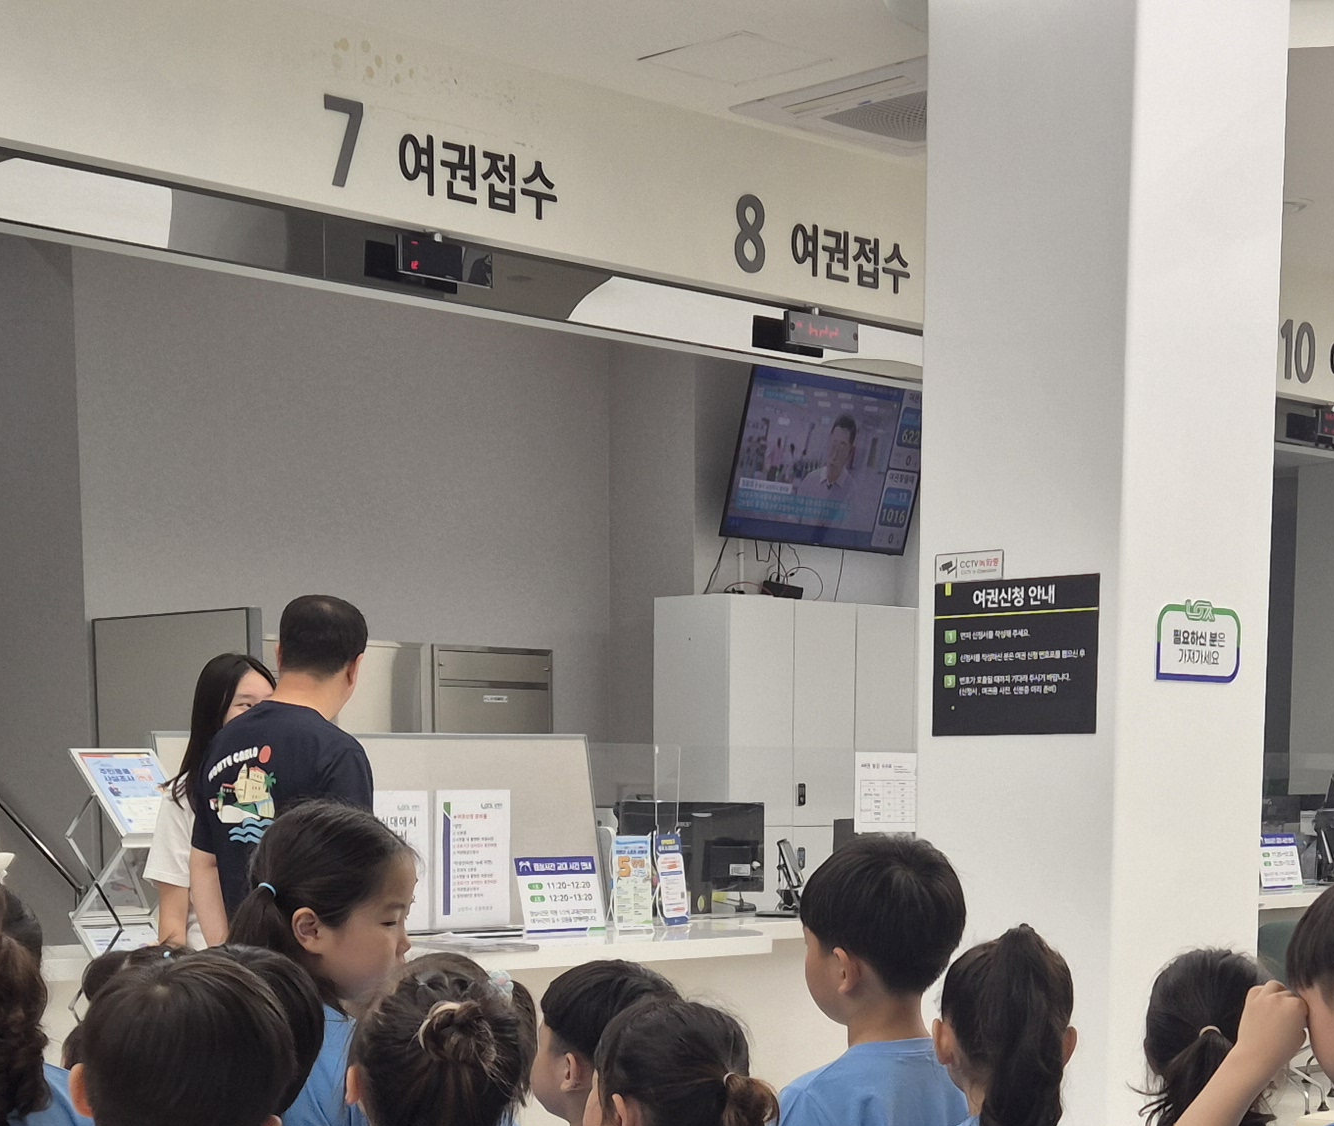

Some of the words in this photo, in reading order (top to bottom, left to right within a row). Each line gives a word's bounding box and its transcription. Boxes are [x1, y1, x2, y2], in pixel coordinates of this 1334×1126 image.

[323, 93, 364, 188] 7
[398, 133, 558, 221] 여권접수
[734, 193, 766, 273] 8
[790, 221, 911, 294] 여권접수
[1280, 319, 1316, 383] 10
[973, 586, 1025, 609] 여권신청
[1028, 584, 1056, 605] 안내
[1173, 629, 1207, 646] 필요하신
[1209, 631, 1226, 648] 분은
[1178, 648, 1219, 665] 가져가세요
[618, 856, 631, 877] 5
